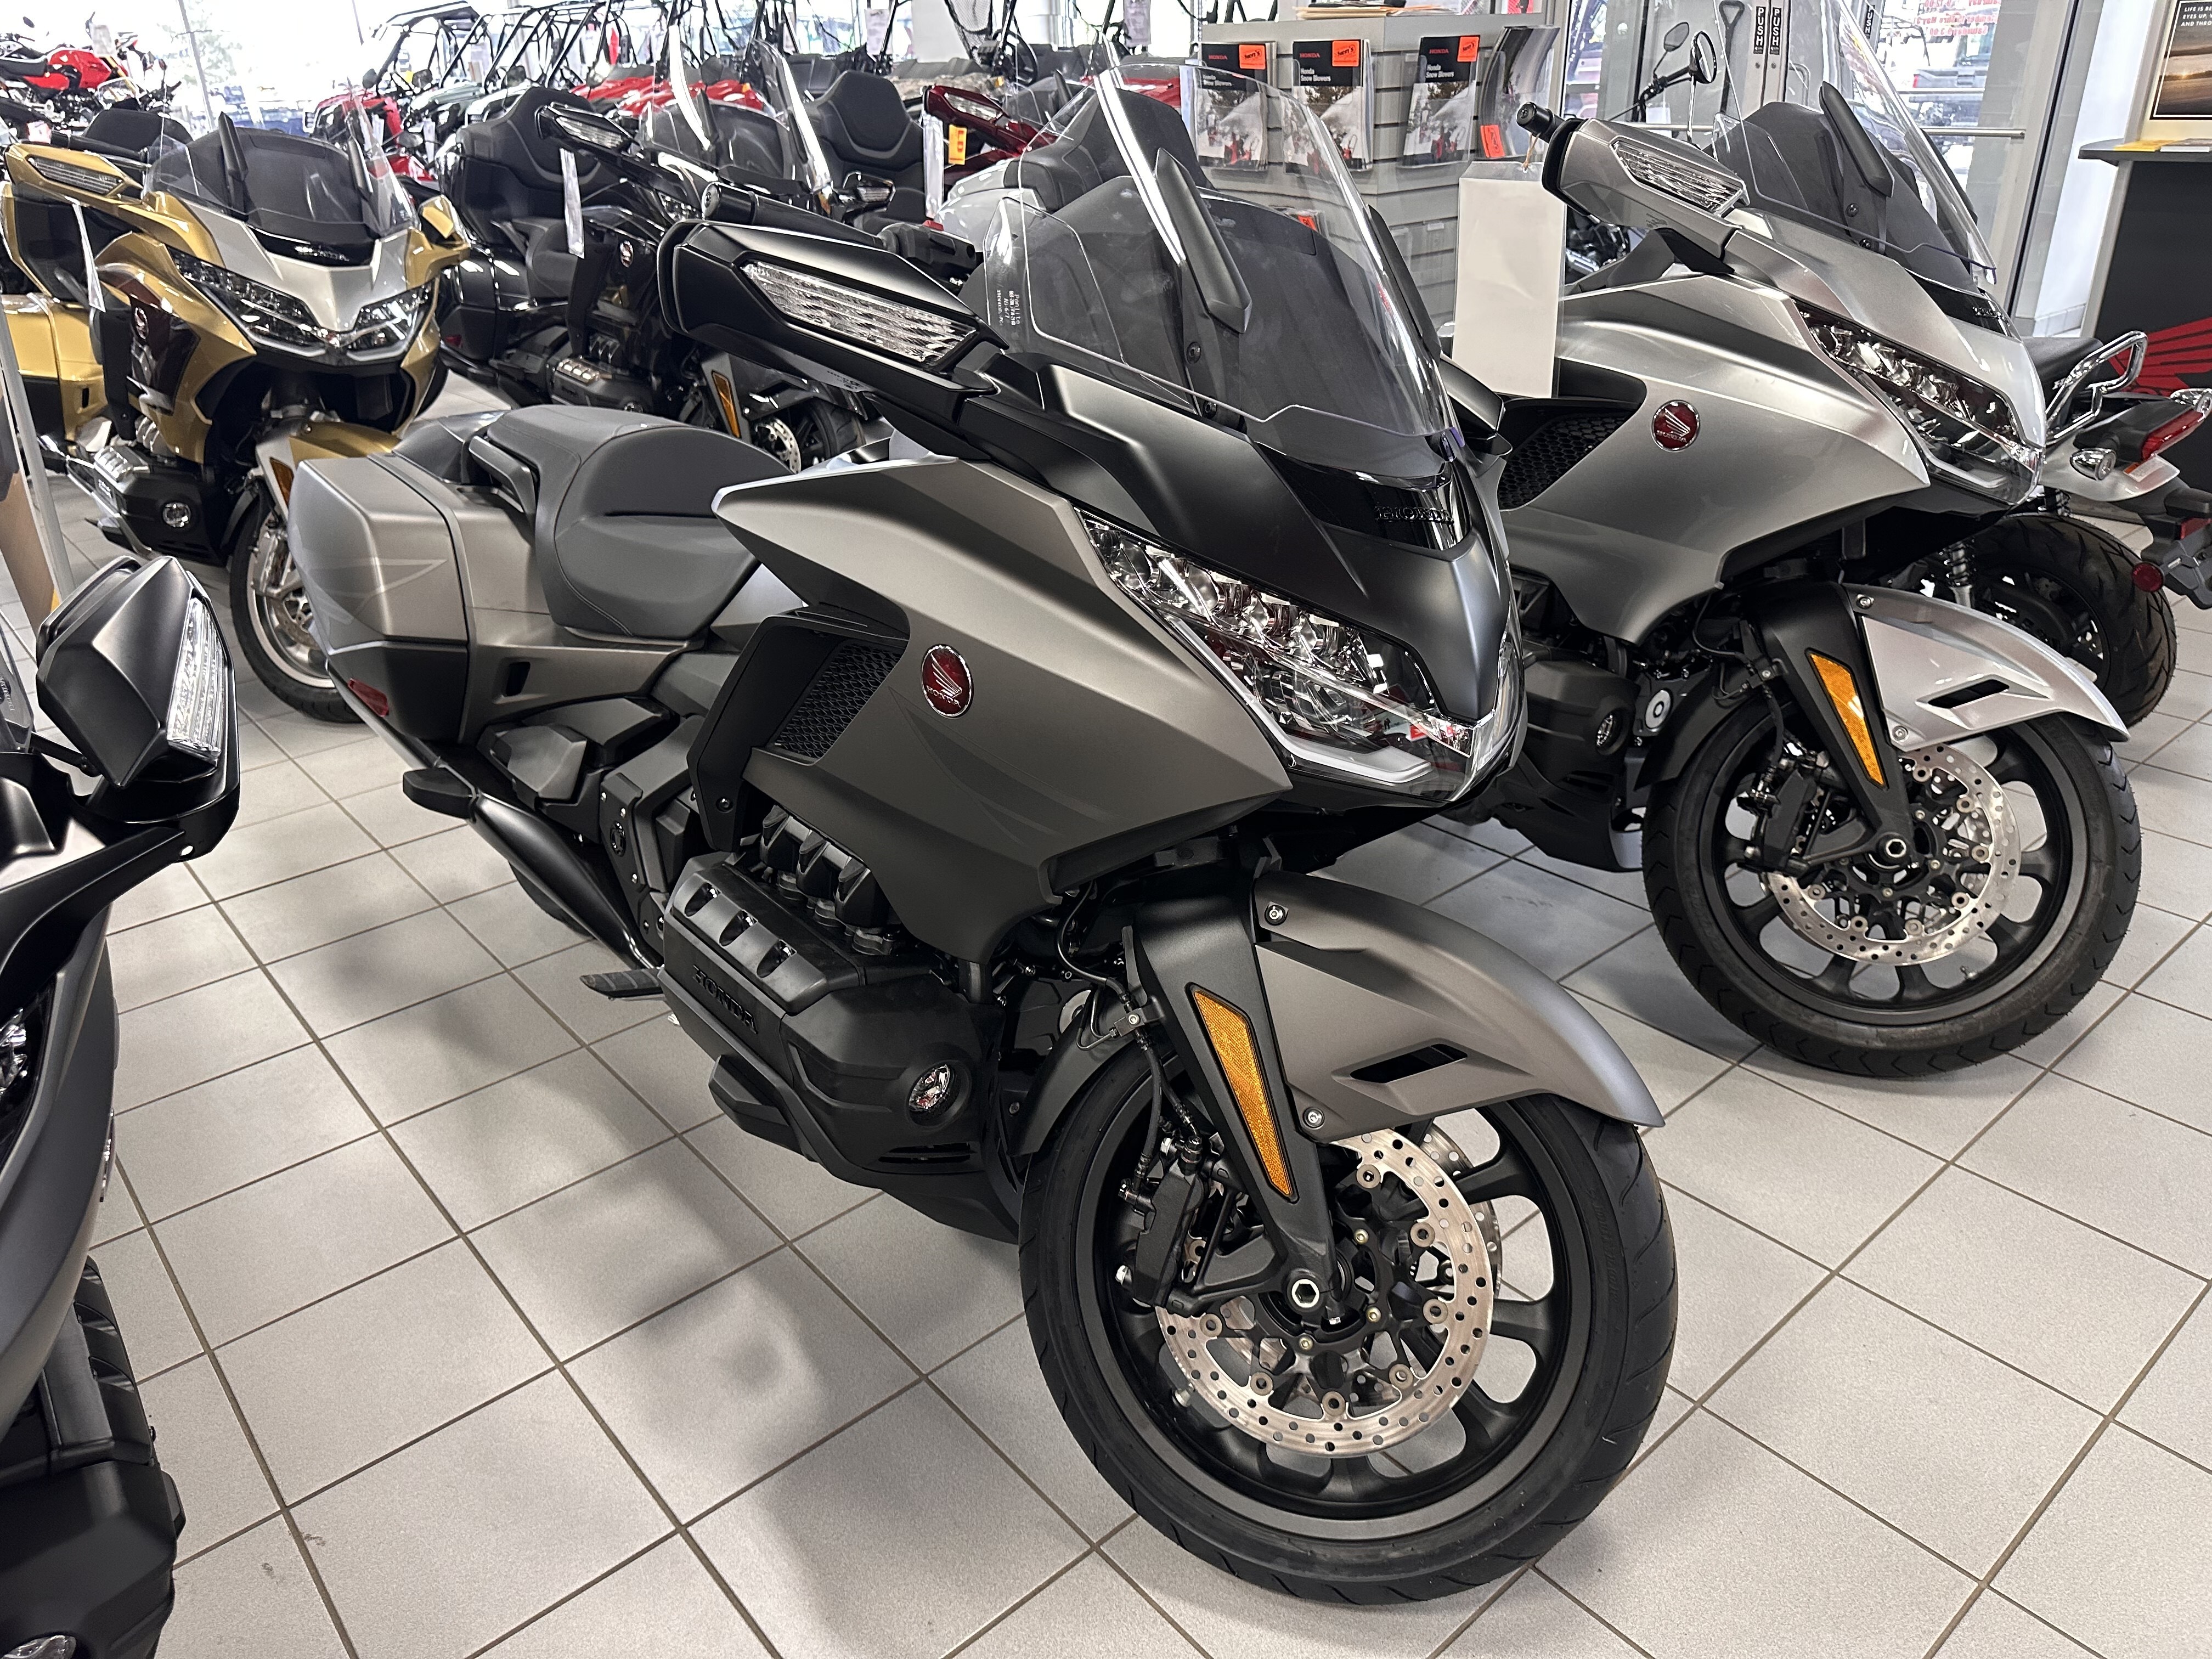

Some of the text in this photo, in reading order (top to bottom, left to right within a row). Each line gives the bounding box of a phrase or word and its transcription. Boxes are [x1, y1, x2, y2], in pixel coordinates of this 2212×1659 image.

[1756, 7, 1764, 46] PUSH
[1772, 8, 1780, 46] PUSH
[1374, 506, 1454, 523] HONDA
[926, 685, 961, 708] HONDA
[692, 964, 759, 1035] HONDA
